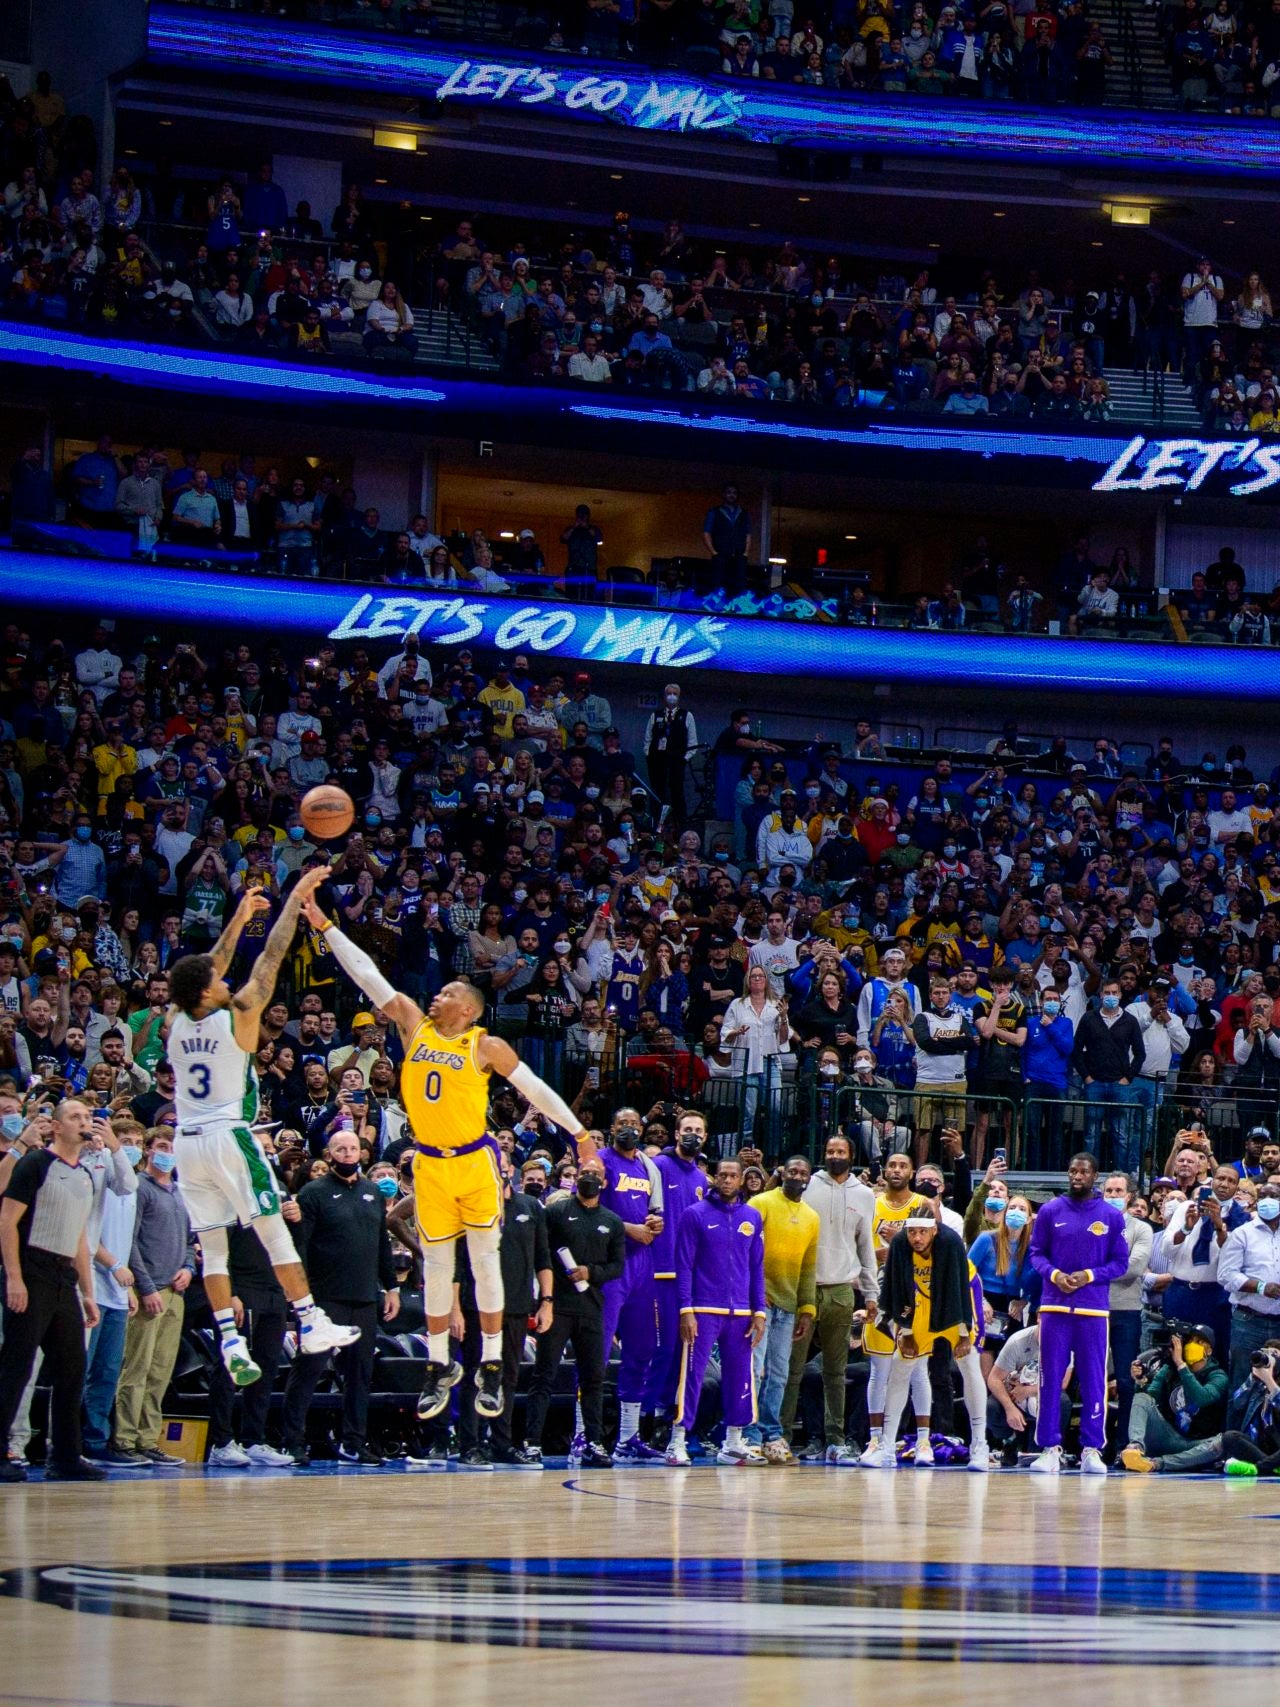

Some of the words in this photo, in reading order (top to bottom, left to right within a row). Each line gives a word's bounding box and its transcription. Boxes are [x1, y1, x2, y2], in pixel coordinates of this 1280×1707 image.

[437, 61, 558, 103] LET'S
[565, 77, 628, 112] GO
[632, 80, 745, 133] MAVS
[328, 592, 485, 645] LET'S
[492, 605, 578, 651] GO
[583, 610, 731, 669] MAVS
[638, 695, 657, 706] 123
[199, 899, 217, 914] 77
[246, 921, 267, 938] 23
[621, 984, 633, 1001] 0
[180, 1037, 220, 1055] BURKE
[410, 1043, 467, 1070] LAKERS
[187, 1063, 211, 1100] 3
[426, 1071, 442, 1102] 0
